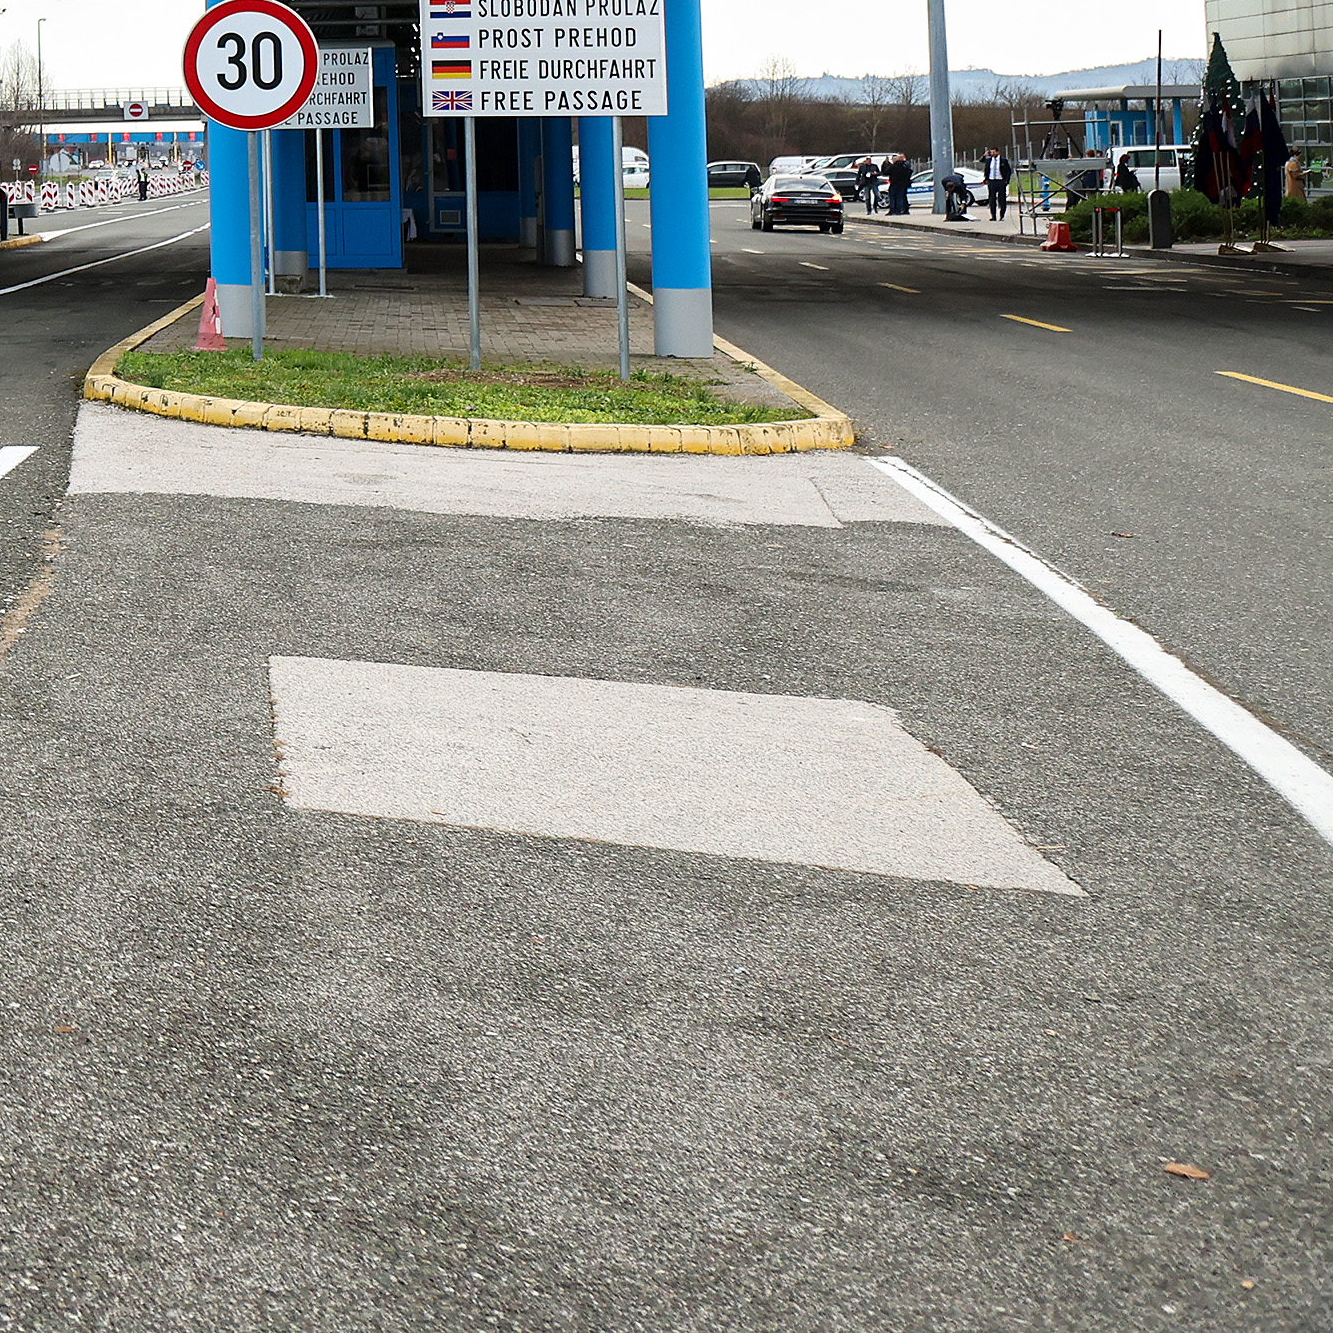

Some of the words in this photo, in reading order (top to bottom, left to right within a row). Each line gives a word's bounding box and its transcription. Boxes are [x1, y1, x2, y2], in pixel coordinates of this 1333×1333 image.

[478, 28, 544, 49] PROST
[555, 27, 637, 48] PREHOD
[216, 31, 283, 91] 30
[323, 52, 369, 66] PROLAZ
[480, 59, 529, 80] FREIE
[538, 58, 656, 79] DURCHFAHRT
[317, 72, 355, 86] EHOD
[307, 92, 367, 106] RCHFAHRT
[481, 91, 534, 111] FREE
[544, 89, 642, 110] PASSAGE
[298, 111, 358, 125] PASSAGE
